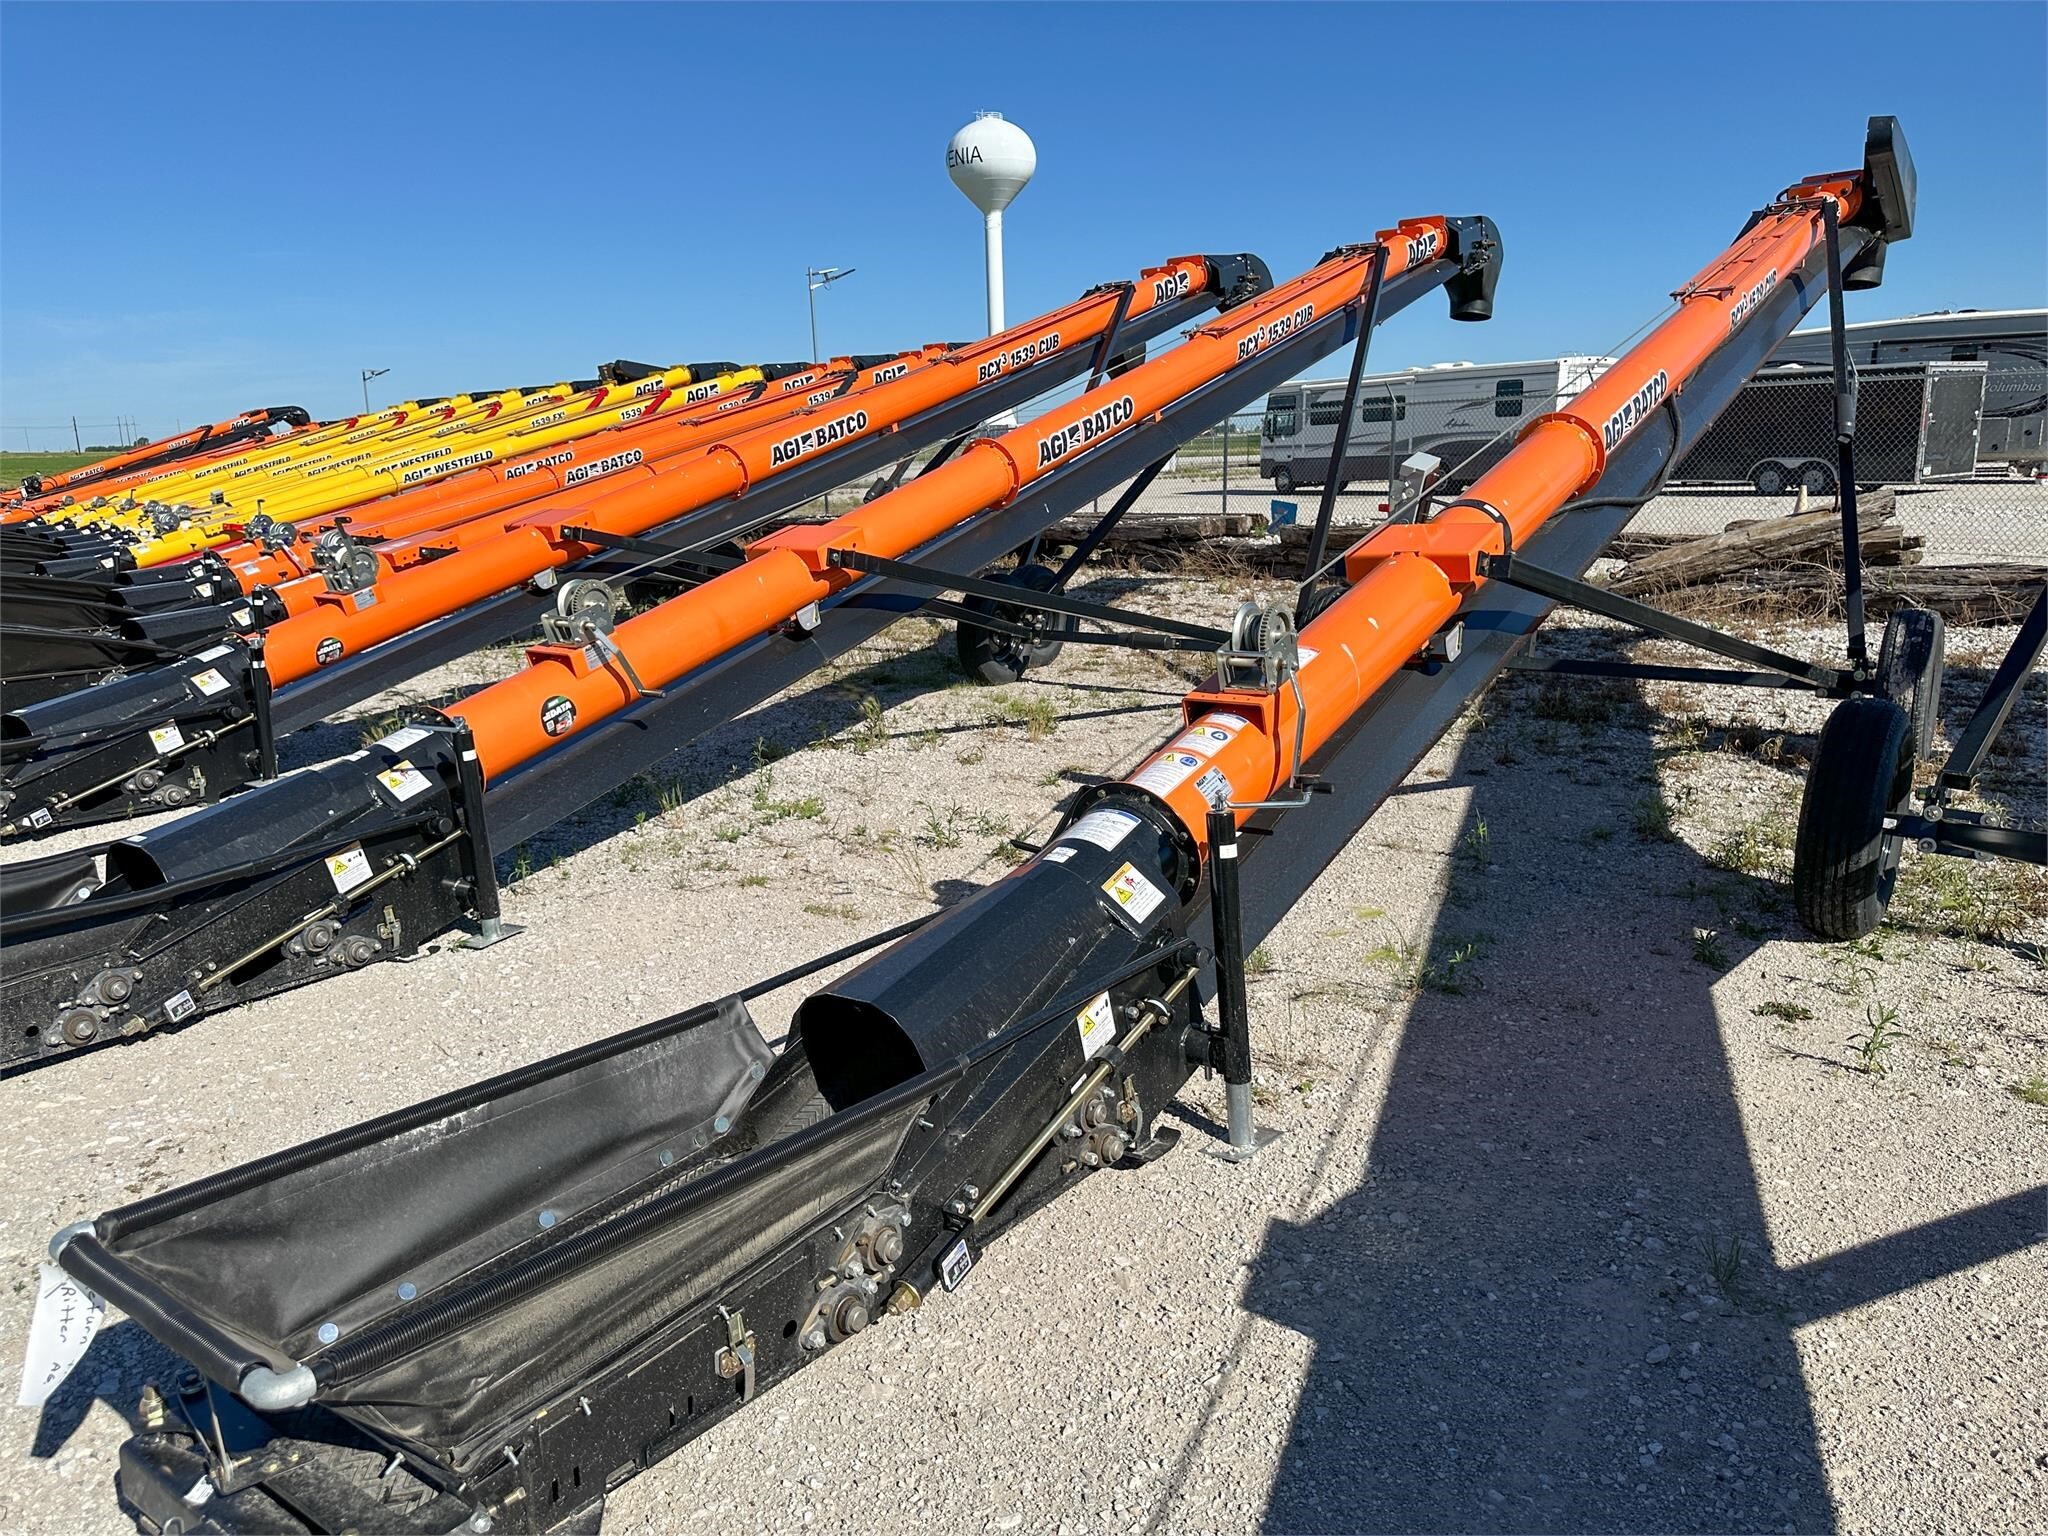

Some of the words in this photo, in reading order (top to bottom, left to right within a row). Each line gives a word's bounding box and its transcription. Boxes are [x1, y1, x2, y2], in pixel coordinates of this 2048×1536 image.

[946, 145, 984, 168] ENIA
[1406, 237, 1428, 268] AGI
[1154, 275, 1178, 305] AGI
[1268, 316, 1292, 344] 1539
[1294, 304, 1313, 330] CUB
[1011, 344, 1036, 367] 1539
[1039, 333, 1060, 355] CUB
[874, 367, 897, 384] AGI
[635, 382, 655, 398] AGI
[686, 386, 708, 403] AGI
[808, 392, 831, 407] 1539
[531, 417, 551, 428] 1539
[621, 408, 642, 420] 1539
[1604, 412, 1624, 452] AGI
[1633, 371, 1668, 427] BATCO
[772, 438, 800, 467] AGI
[816, 411, 868, 448] BATCO
[1039, 431, 1068, 468] AGI
[1082, 397, 1134, 443] BATCO
[212, 458, 248, 474] WESTFIELD
[253, 456, 291, 472] WESTFIELD
[401, 447, 452, 469] WESTFIELD
[404, 469, 424, 484] AGI
[434, 450, 493, 474] WESTFIELD
[506, 466, 525, 480] AGI
[536, 452, 573, 471] BATCO
[567, 466, 589, 484] AGI
[601, 450, 642, 473] BATCO
[80, 1289, 100, 1345] eturn
